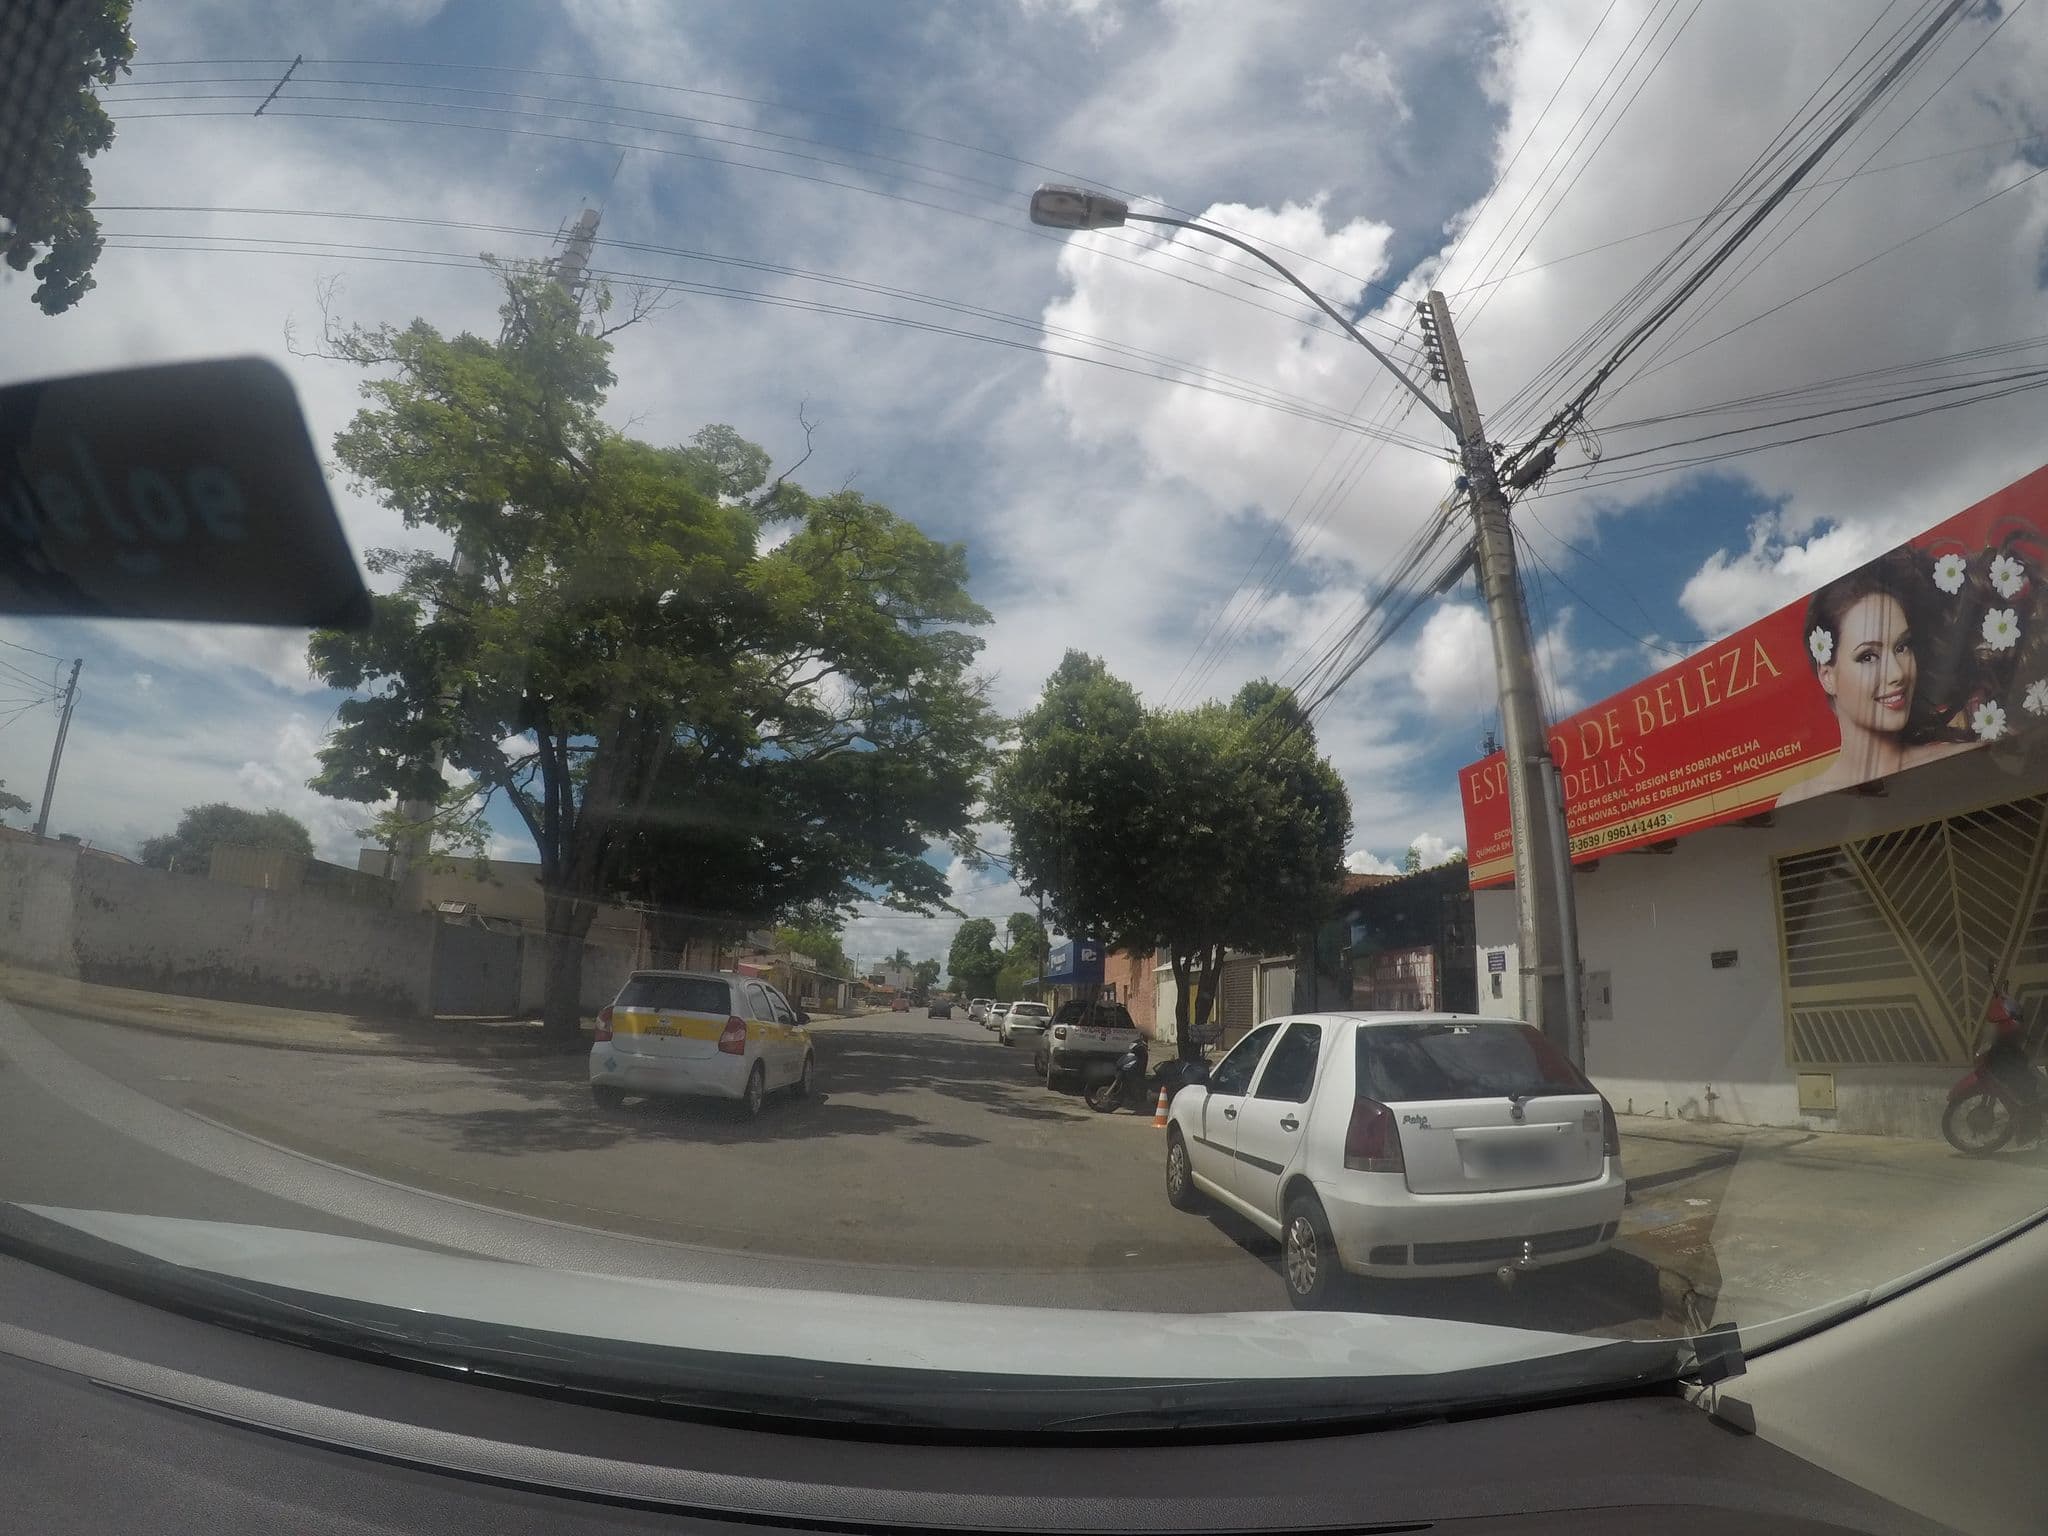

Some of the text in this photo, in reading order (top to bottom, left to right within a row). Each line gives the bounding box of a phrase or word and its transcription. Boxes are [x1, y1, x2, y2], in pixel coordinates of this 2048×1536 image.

[1578, 708, 1624, 760] DE
[1632, 638, 1782, 737] BELEZA
[1563, 745, 1646, 801] DELLA'S
[1566, 801, 1588, 817] AÇÃO
[1589, 797, 1600, 809] EM
[1601, 788, 1629, 804] GERAL
[1635, 773, 1668, 793] DESIGN
[1669, 768, 1684, 781] EM
[1685, 738, 1761, 775] SOBRANCELHA
[1576, 815, 1588, 827] DE
[1588, 805, 1620, 824] NOIVAS,
[1621, 794, 1651, 812] DAMAS
[1652, 791, 1659, 802] E
[1659, 770, 1722, 800] DEBUTANTES
[1733, 741, 1802, 775] MAQUIAGEM
[1569, 834, 1600, 852] 3-3639
[1607, 813, 1667, 842] 99614-1443
